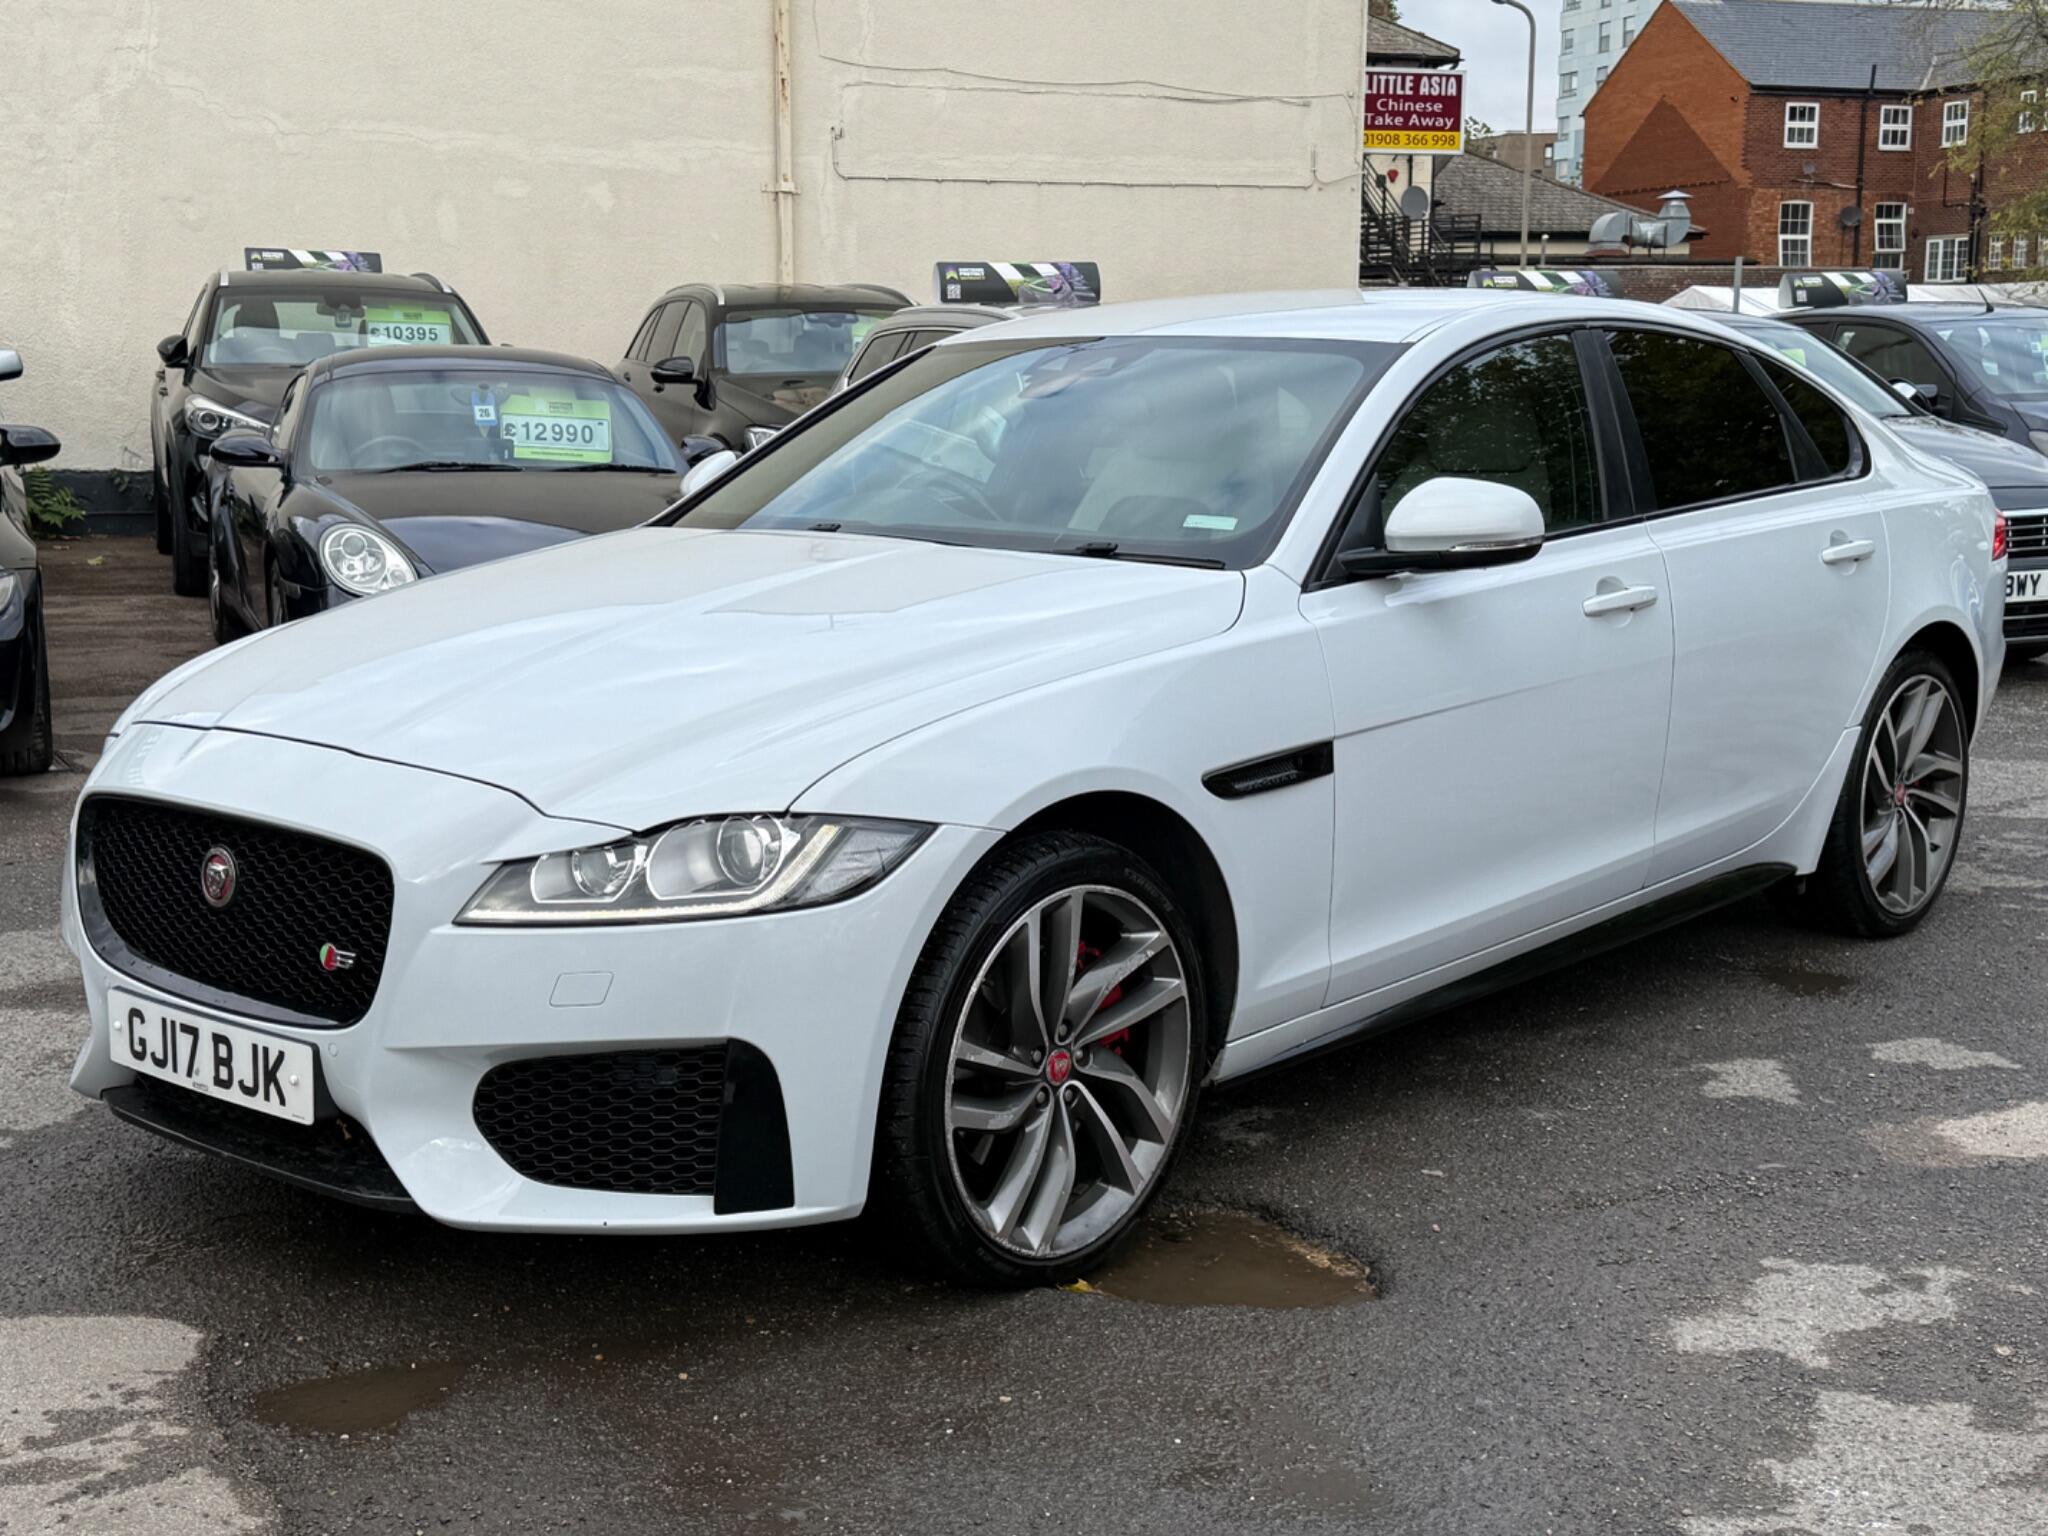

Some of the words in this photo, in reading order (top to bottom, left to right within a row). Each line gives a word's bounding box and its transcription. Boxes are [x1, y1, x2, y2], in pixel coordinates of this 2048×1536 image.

[1365, 74, 1414, 95] LITTLE
[1420, 75, 1457, 96] ASIA
[1376, 98, 1443, 112] Chinese
[1364, 112, 1404, 126] Take
[1408, 113, 1455, 130] Away
[1404, 133, 1428, 146] 366
[1431, 134, 1456, 147] 998
[504, 422, 594, 444] £12990
[127, 1007, 200, 1079] GJ17
[211, 1031, 286, 1107] BJK
